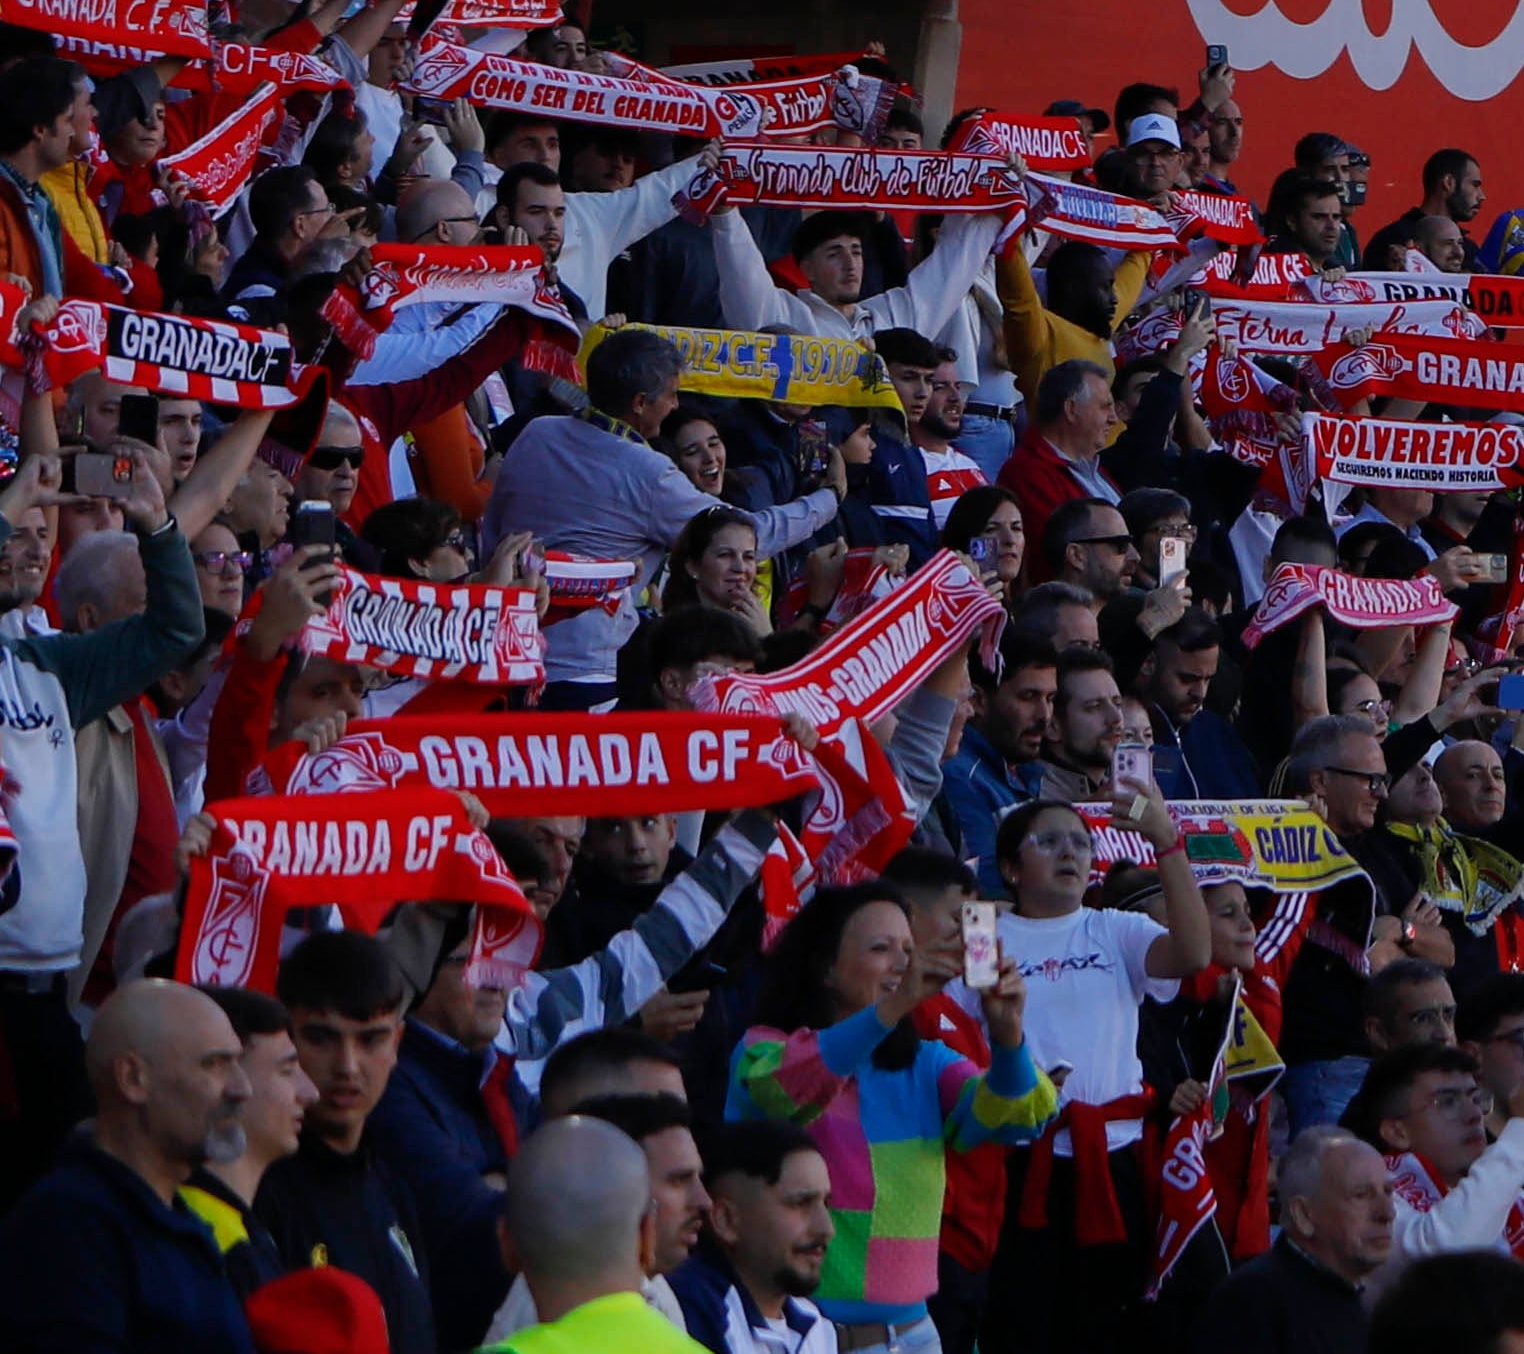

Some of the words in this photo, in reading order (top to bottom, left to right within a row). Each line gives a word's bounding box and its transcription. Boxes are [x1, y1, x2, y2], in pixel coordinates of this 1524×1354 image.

[124, 0, 166, 36] C.F.
[472, 70, 530, 107] COMO
[533, 82, 569, 110] SER
[572, 89, 608, 117] DEL
[612, 93, 706, 127] GRANADA
[751, 152, 836, 199] Granada
[839, 153, 890, 197] Club
[892, 157, 915, 191] de
[918, 157, 979, 199] Fútbol
[1312, 416, 1520, 467] VOLVEREMOS
[1335, 461, 1401, 483] SEGUIREMOS
[1401, 466, 1445, 483] HACIENDO
[1449, 468, 1497, 483] HISTORIA
[422, 730, 678, 788] GRANADA
[687, 725, 751, 783] CF
